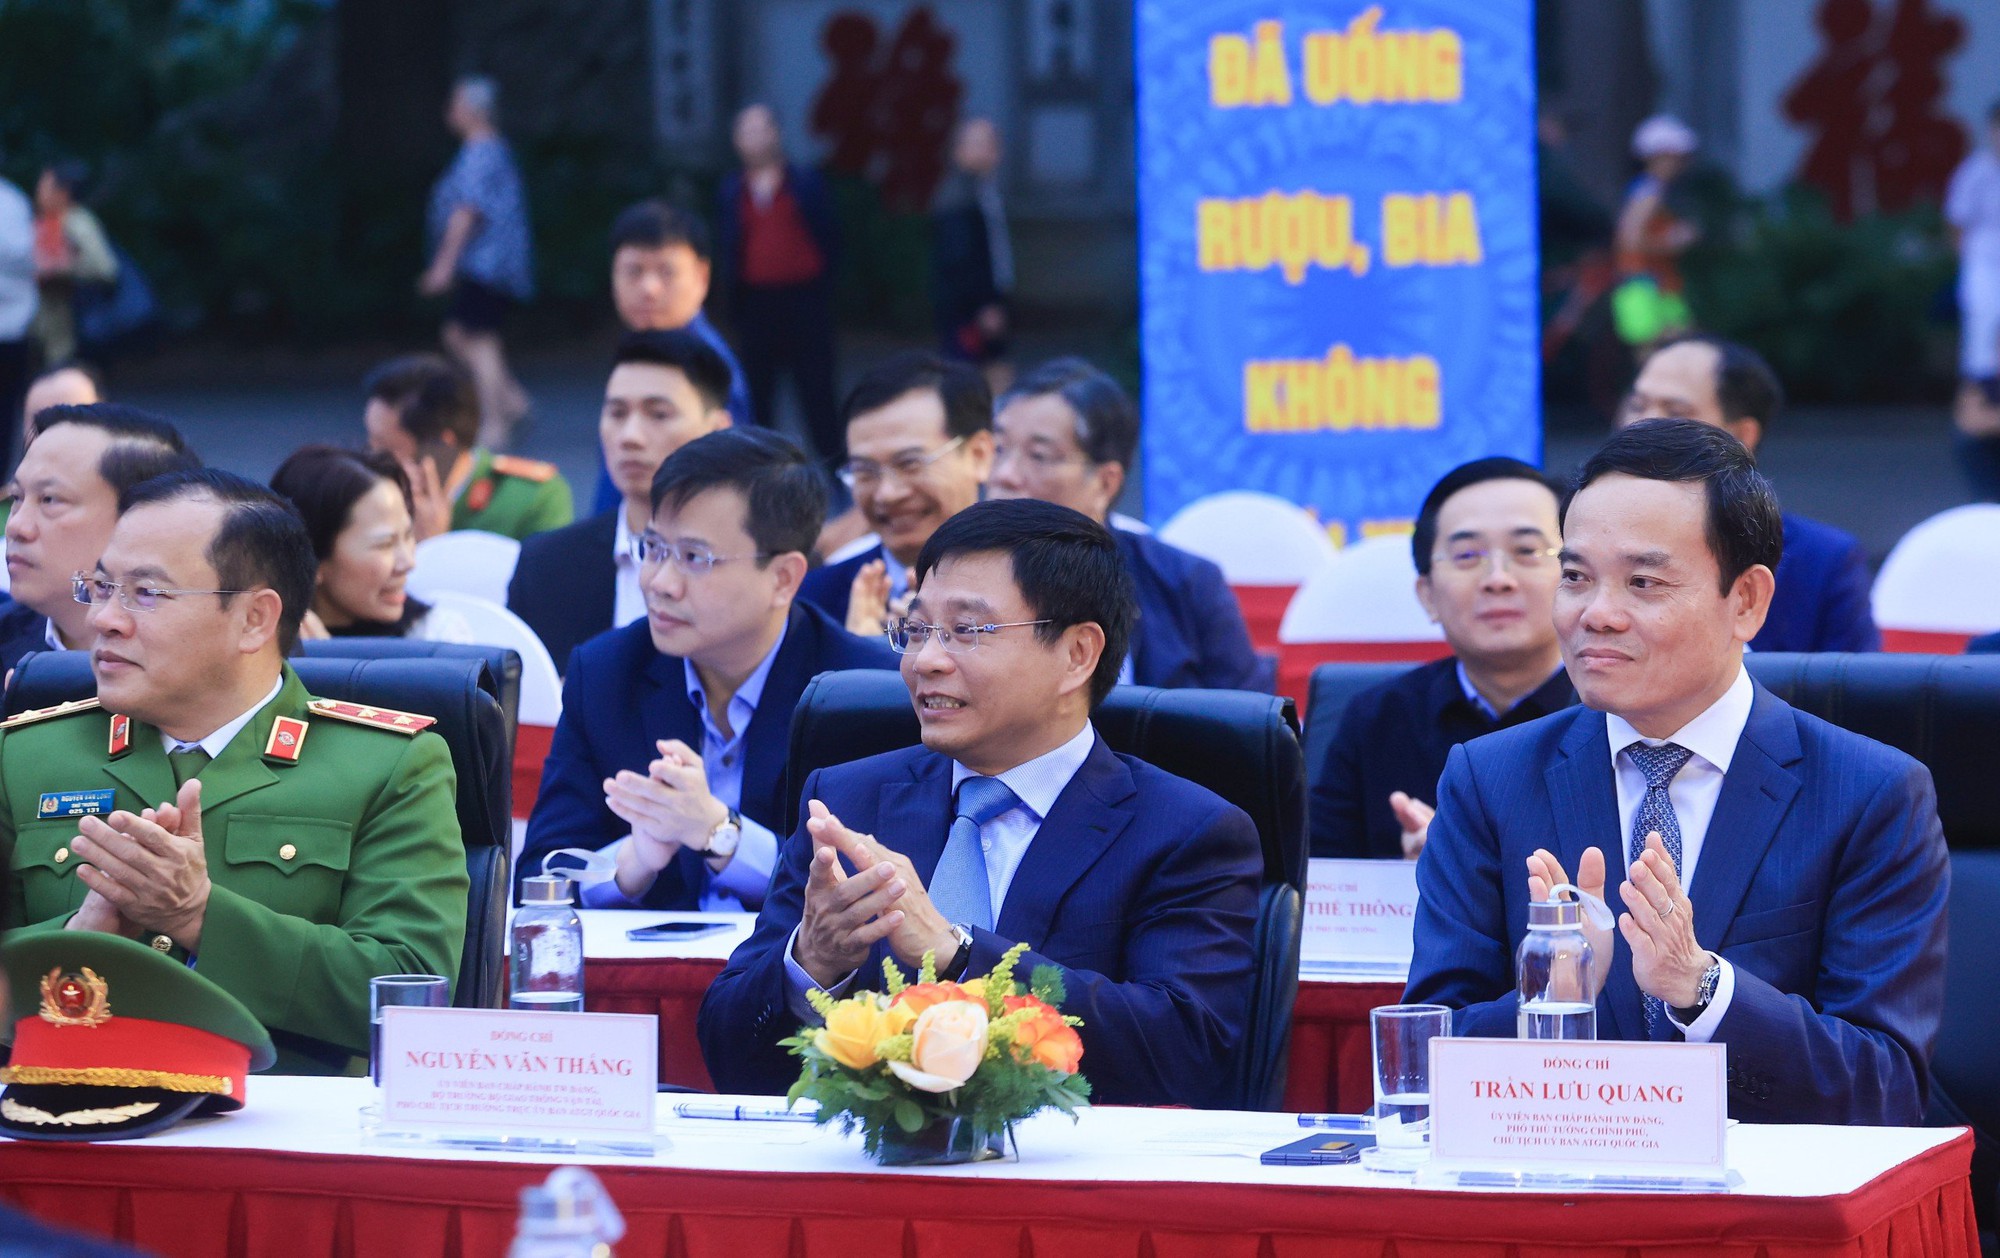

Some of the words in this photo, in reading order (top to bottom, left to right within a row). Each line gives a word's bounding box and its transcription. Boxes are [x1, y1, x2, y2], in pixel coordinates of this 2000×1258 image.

[1382, 192, 1482, 266] BIA
[1243, 343, 1442, 432] KHÔNG
[503, 1051, 548, 1072] VĂN
[1543, 1057, 1581, 1069] ĐỒNG
[1586, 1056, 1609, 1070] CHÍ
[1543, 1080, 1590, 1101] LƯU
[1598, 1083, 1683, 1105] QUANG
[1532, 1113, 1552, 1122] BAN
[1641, 1140, 1660, 1149] GIA
